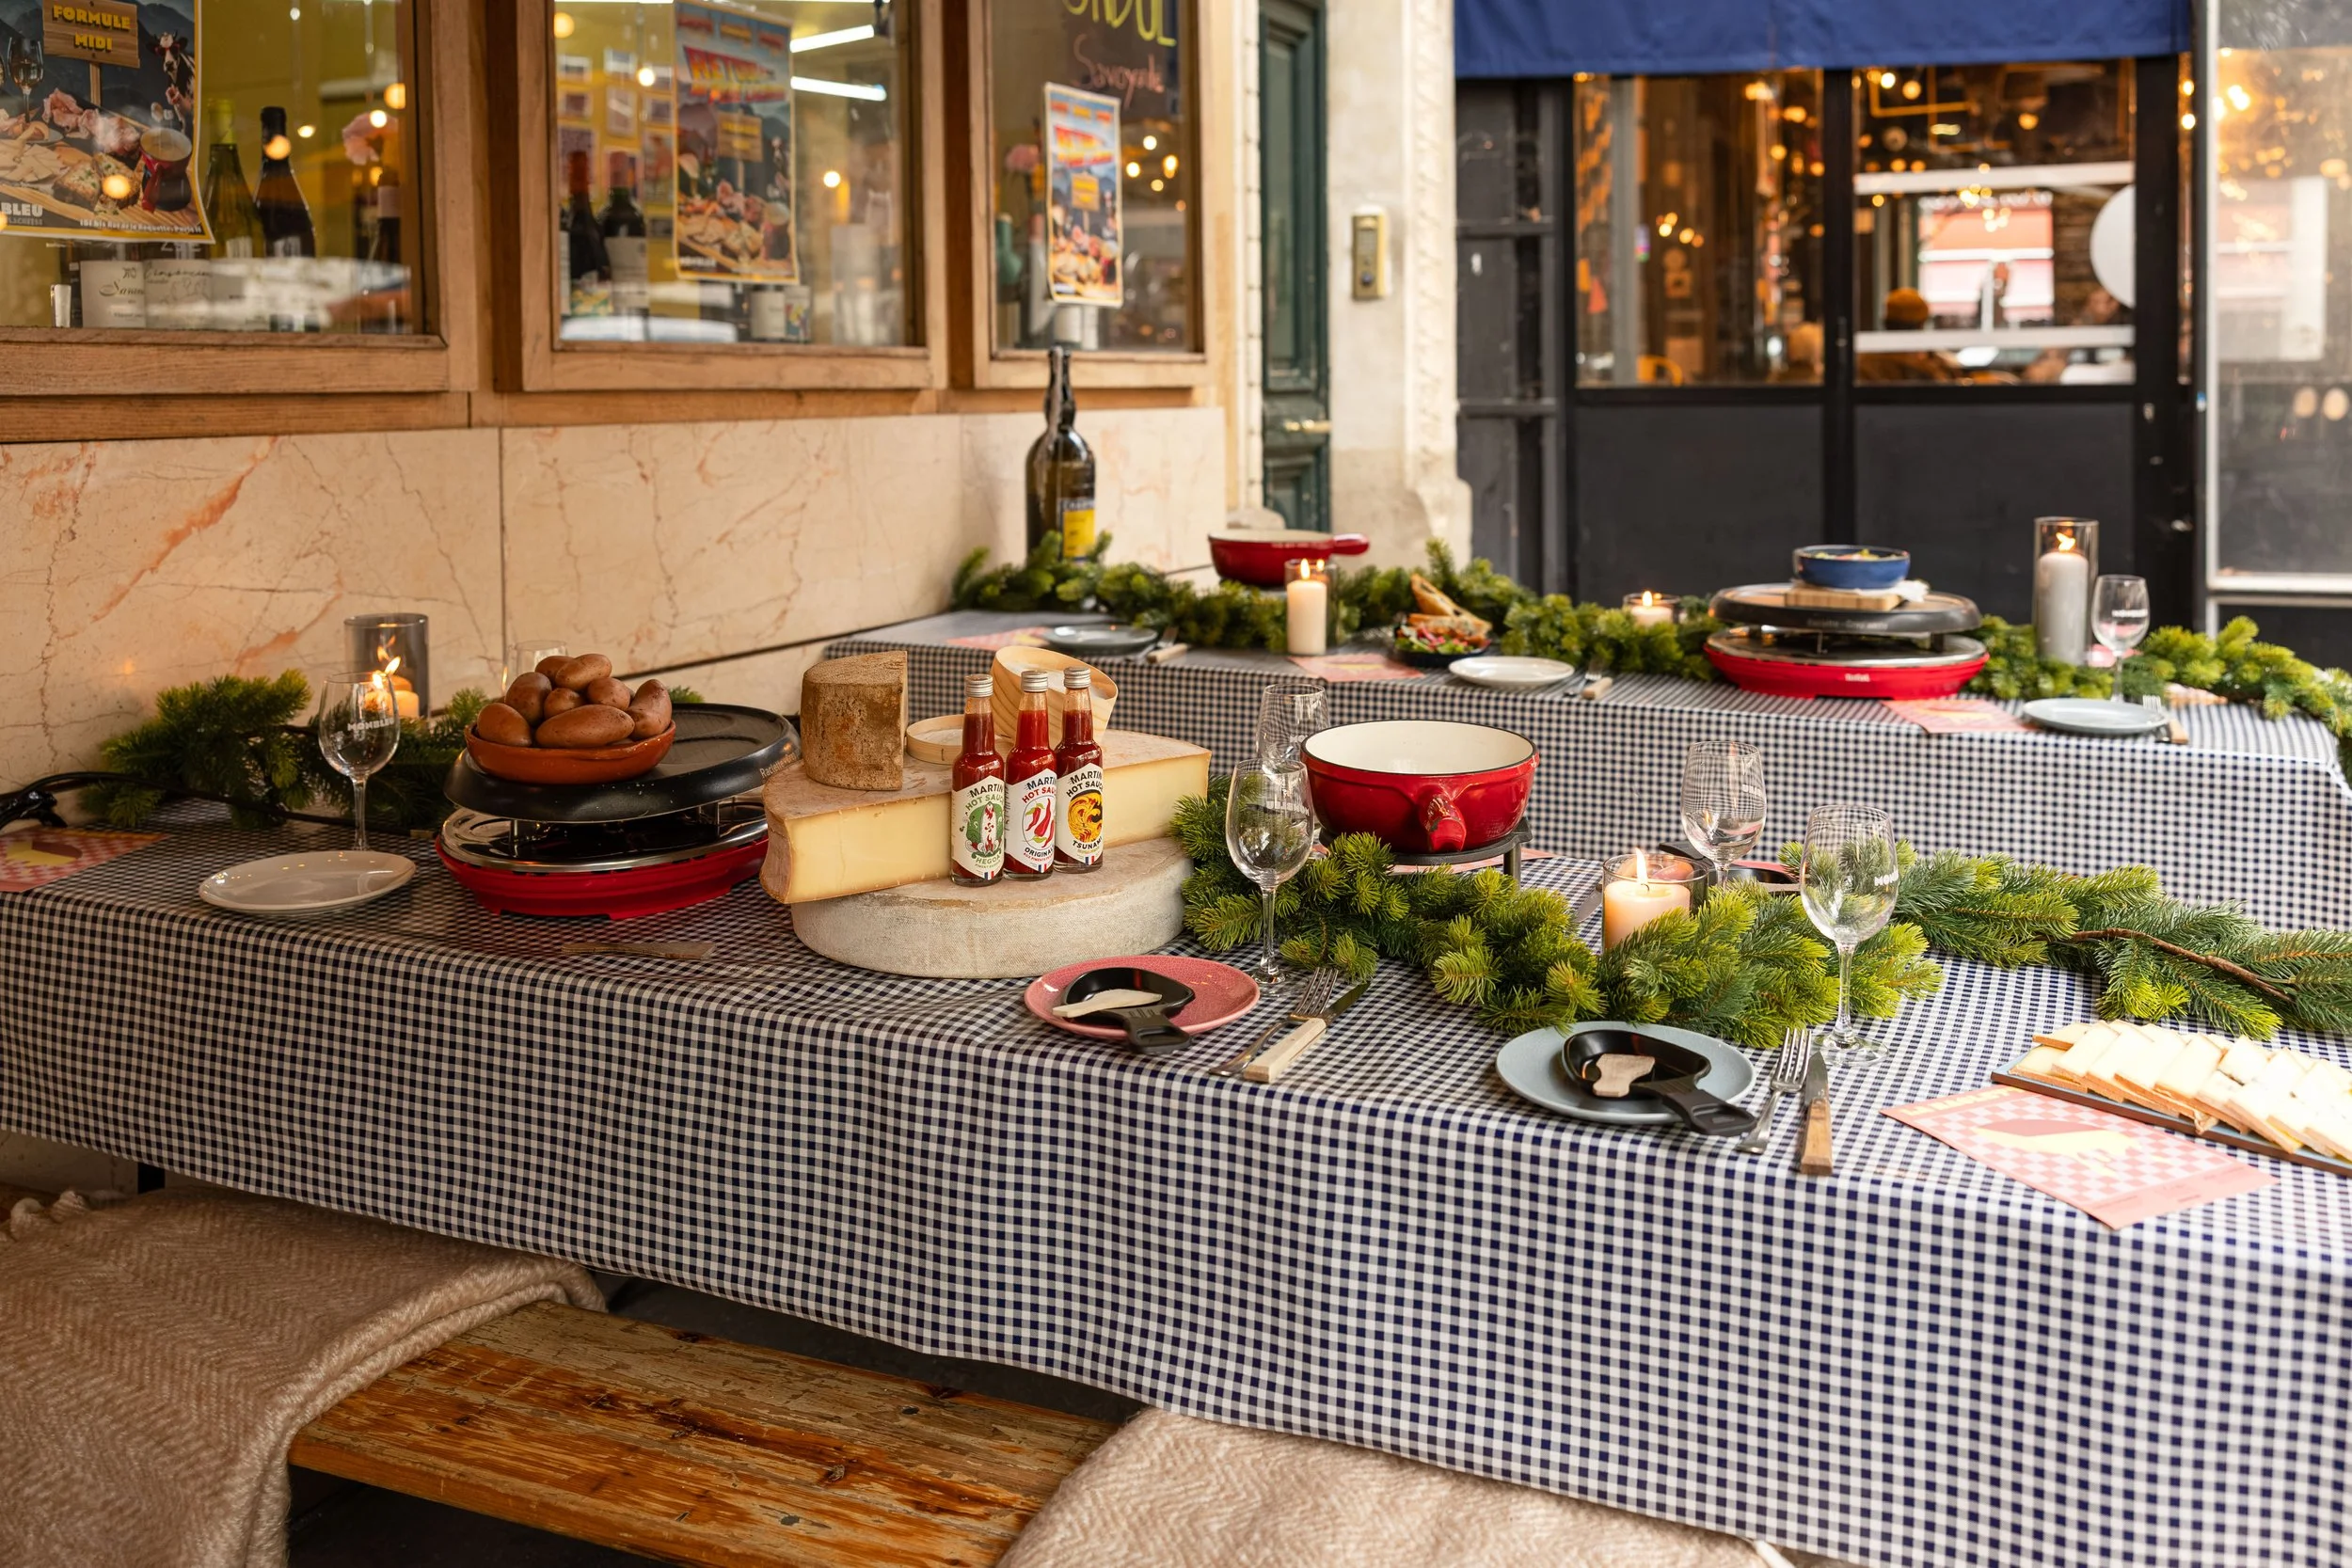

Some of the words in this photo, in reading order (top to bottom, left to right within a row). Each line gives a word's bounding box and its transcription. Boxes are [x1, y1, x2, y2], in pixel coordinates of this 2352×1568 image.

[53, 5, 131, 31] FORMULE
[74, 33, 113, 53] MIDI
[347, 718, 395, 732] MONBLEU
[1022, 788, 1040, 803] HOT
[1066, 783, 1083, 797] HOT
[965, 797, 983, 811] HOT
[1073, 835, 1103, 849] TSUNAMI
[976, 855, 1001, 864] HEGOA
